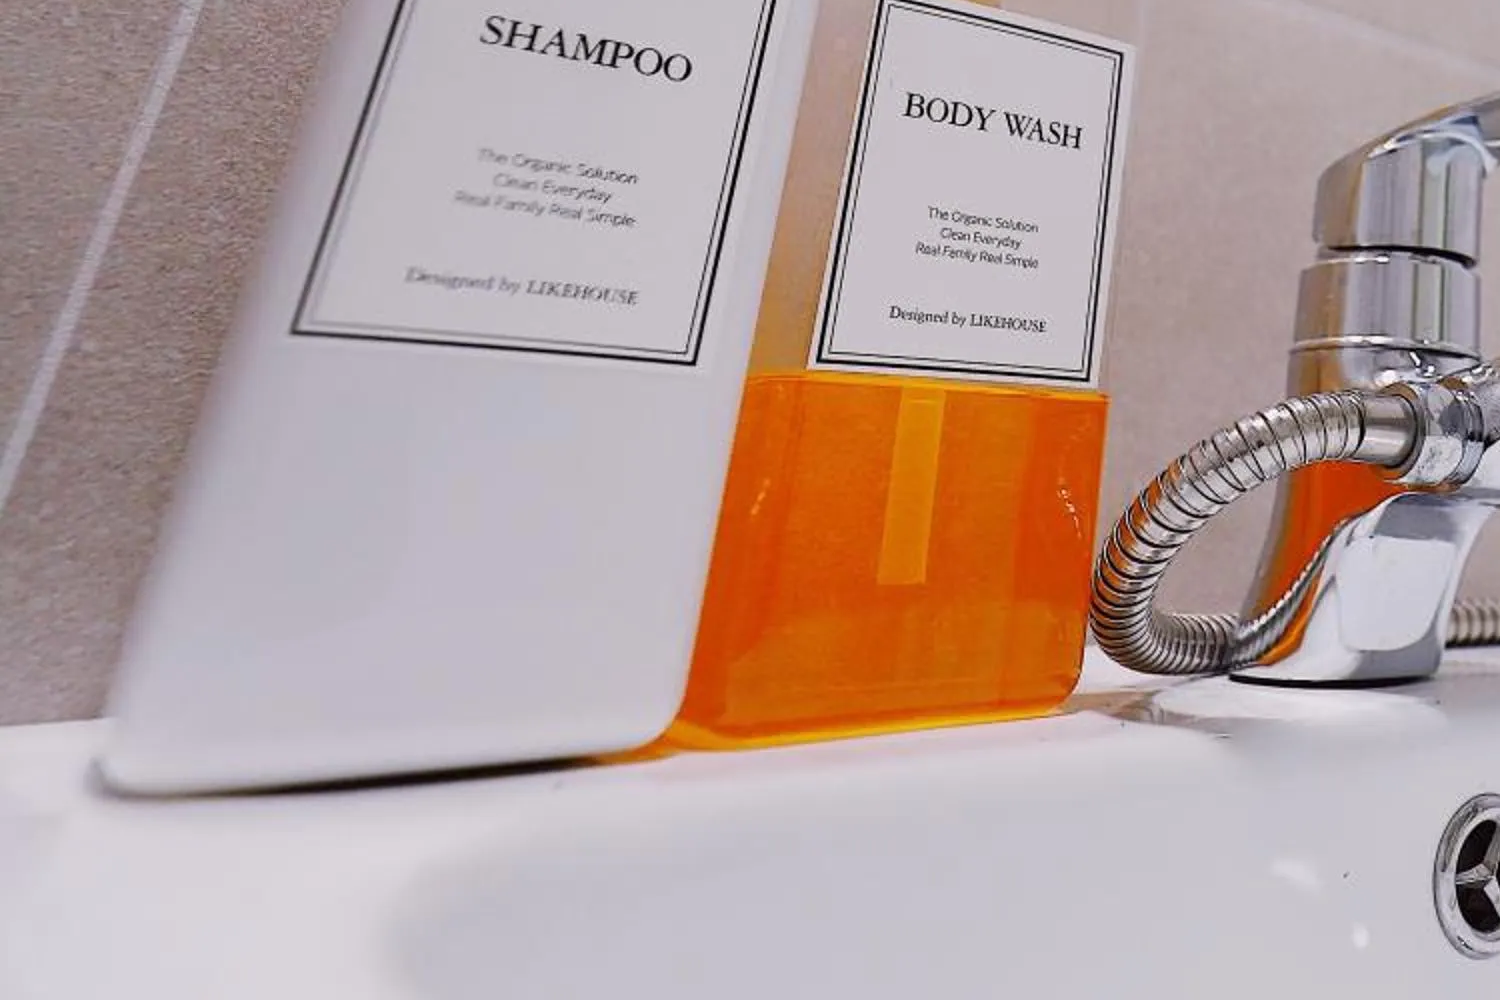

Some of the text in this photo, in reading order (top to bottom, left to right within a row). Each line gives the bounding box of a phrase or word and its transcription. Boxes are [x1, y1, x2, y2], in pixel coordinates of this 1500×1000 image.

[479, 14, 693, 83] SHAMPOO
[901, 91, 1083, 150] BODY WASH
[477, 147, 639, 185] The Organic Solution
[492, 172, 612, 204] Clean Everyday
[492, 194, 546, 217] Family
[585, 207, 637, 230] Simple
[927, 205, 1039, 234] The Organic Solution
[915, 241, 1040, 269] Real Family Real Simple
[940, 227, 1022, 250] Clean Everyday
[403, 265, 640, 307] Designed by LIKEHOUSE
[889, 305, 1048, 333] Designed by LIKEHOUSE
